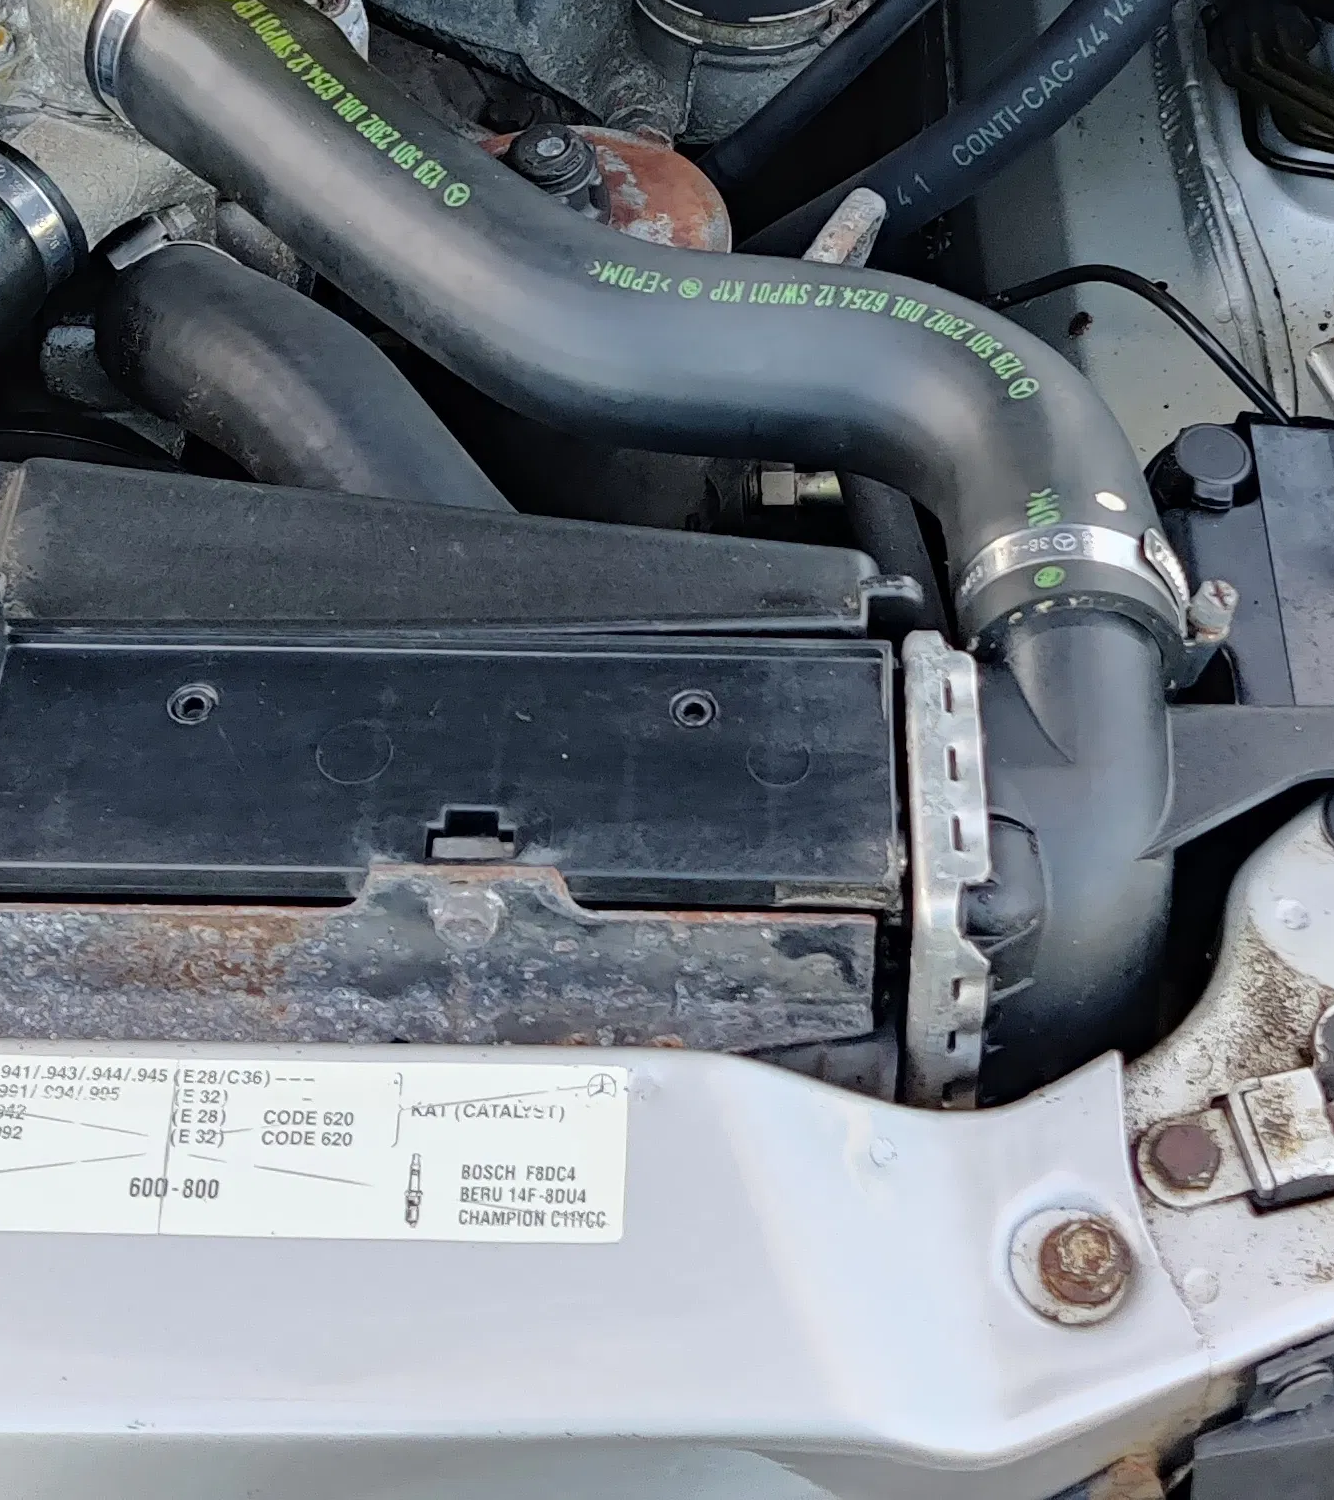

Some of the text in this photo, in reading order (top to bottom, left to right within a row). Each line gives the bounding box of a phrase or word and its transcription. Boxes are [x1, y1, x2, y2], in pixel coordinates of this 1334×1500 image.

[333, 93, 368, 123] DBL
[951, 23, 1110, 166] CONTI-CAC-44
[356, 113, 401, 150] 2382
[388, 141, 423, 169] 501
[413, 160, 448, 189] 129
[587, 260, 673, 293] >EPDM<
[749, 282, 812, 306] SWP01
[818, 284, 889, 313] 6254.12
[894, 294, 928, 321] DBL
[924, 306, 976, 340] 2382
[967, 332, 1003, 362] 501
[990, 351, 1025, 379] 129
[199, 1088, 229, 1106] 32)
[197, 1109, 227, 1127] 28)
[263, 1109, 318, 1126] CODE
[323, 1110, 355, 1127] 620
[195, 1130, 225, 1149] 32)
[261, 1130, 317, 1146] CODE
[321, 1131, 353, 1147] 620
[461, 1164, 576, 1182] BOSCH F8DC4
[460, 1186, 586, 1204] BERU 14F-8DU4
[458, 1209, 546, 1227] CHAMPION
